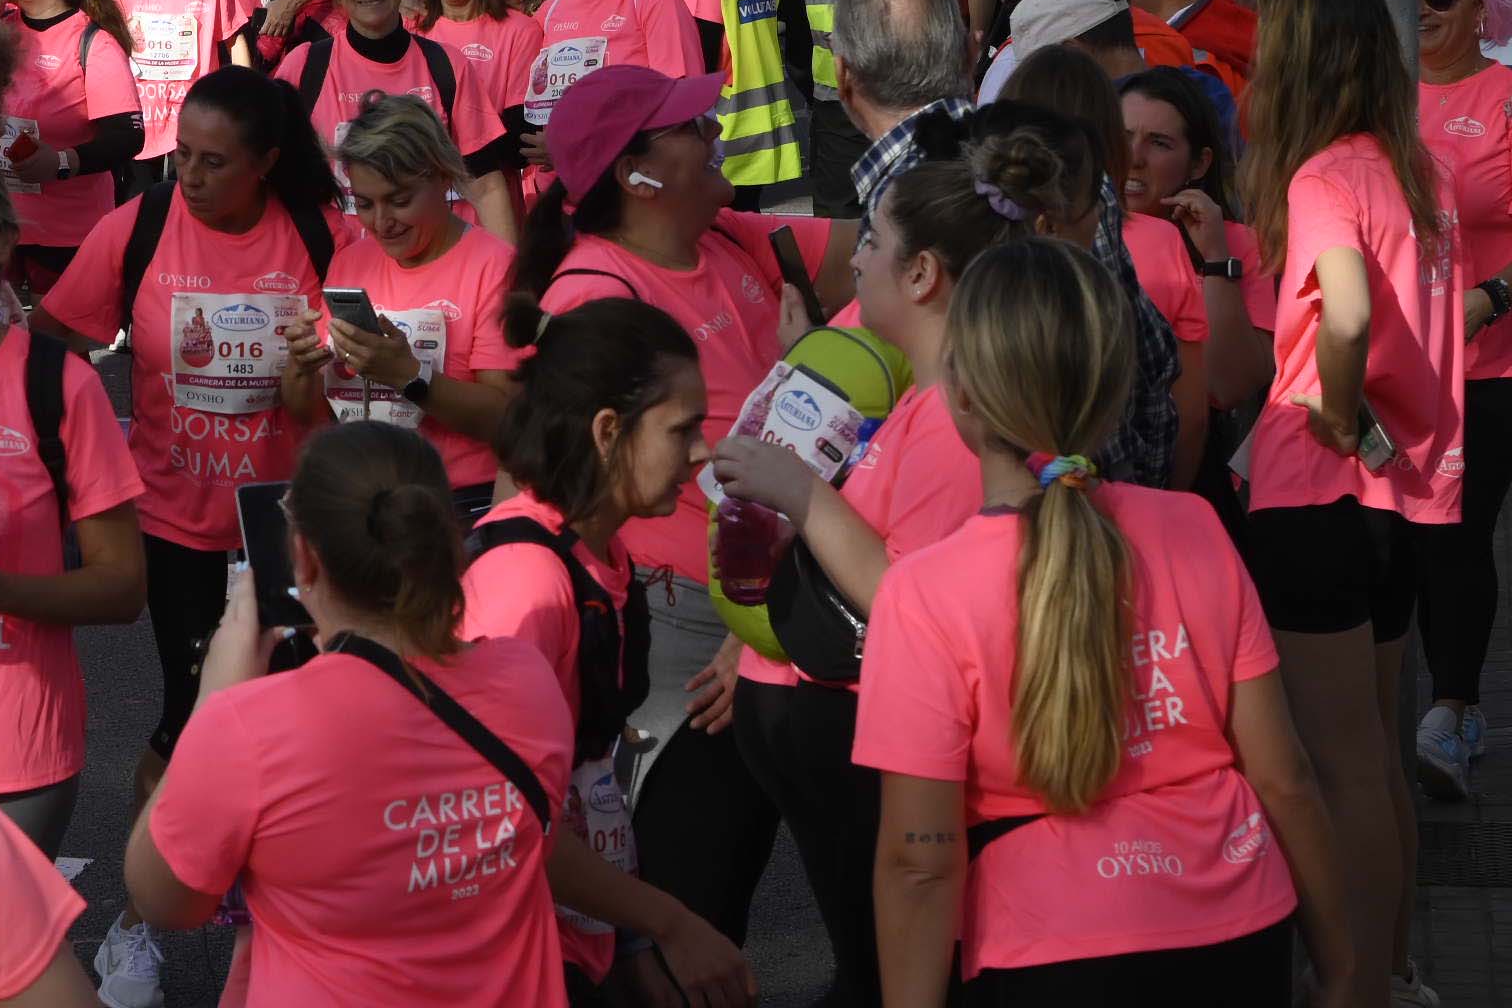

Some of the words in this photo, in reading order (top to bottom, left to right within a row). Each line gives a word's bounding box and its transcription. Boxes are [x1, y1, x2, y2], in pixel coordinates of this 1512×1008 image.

[147, 40, 173, 50] 016
[549, 72, 577, 86] 016
[136, 83, 187, 99] DORSA
[142, 104, 178, 121] UMA
[159, 273, 211, 289] OYSHO
[216, 313, 266, 325] ASTURIANA
[218, 342, 263, 359] 016
[225, 363, 254, 375] 1483
[188, 376, 224, 386] CARRERA
[225, 379, 236, 387] DE
[237, 379, 247, 387] LA
[248, 379, 275, 387] MUJER
[186, 391, 224, 404] OYSHO
[171, 407, 283, 442] DORSAL
[171, 445, 257, 478] SUMA
[384, 781, 524, 832] CARRER
[416, 824, 472, 859] DE
[476, 819, 517, 851] LA
[408, 843, 518, 893] MUJER
[1097, 852, 1183, 879] OYSHO
[451, 884, 480, 901] 2023
